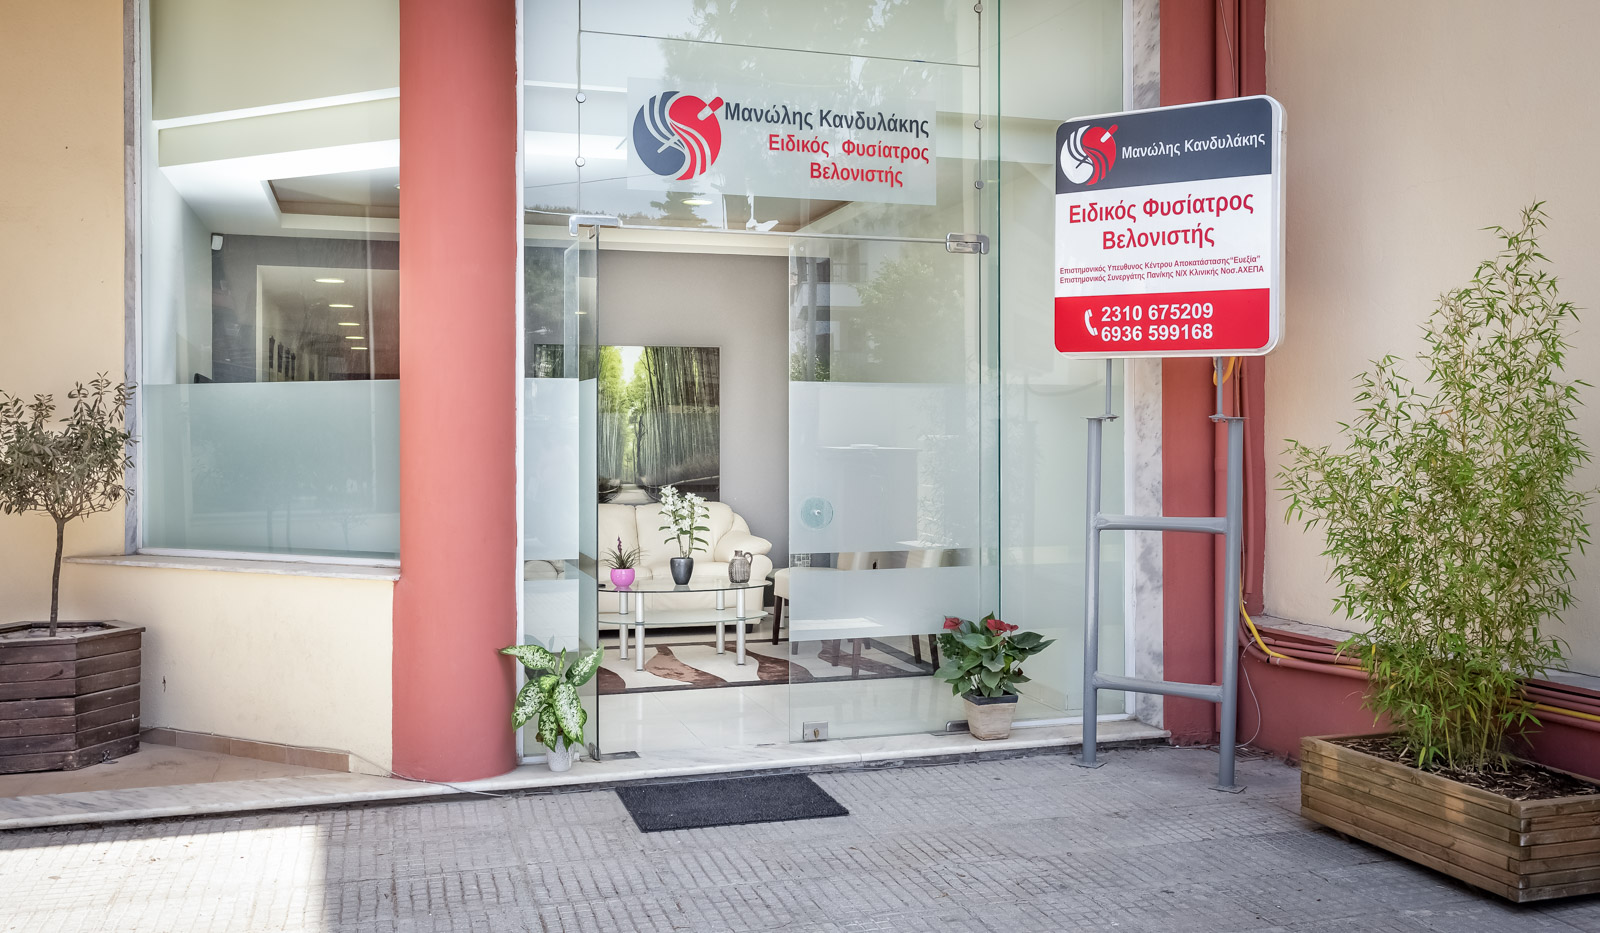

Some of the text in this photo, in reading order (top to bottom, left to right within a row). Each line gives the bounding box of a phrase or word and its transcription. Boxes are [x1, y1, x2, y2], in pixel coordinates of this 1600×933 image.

[724, 101, 929, 138] Μανώλης Κανδυλάκης
[769, 134, 929, 164] Ειδικός Φυσίατρος
[1121, 132, 1266, 159] Μανώλης Κανδυλάκης
[810, 162, 903, 188] Βελονιστής
[1069, 193, 1254, 224] Ειδικός Φυσίατρος
[1103, 223, 1215, 250] Βελονιστής
[1060, 265, 1106, 274] Επιστημονικός
[1144, 261, 1173, 269] Κέντρου
[1060, 275, 1106, 284] Επιστημονικός
[1107, 272, 1145, 281] Συνεργάτης
[1189, 268, 1219, 276] Κλινικής
[1101, 302, 1213, 322] 2310 675209
[1101, 323, 1213, 342] 6936 599168
